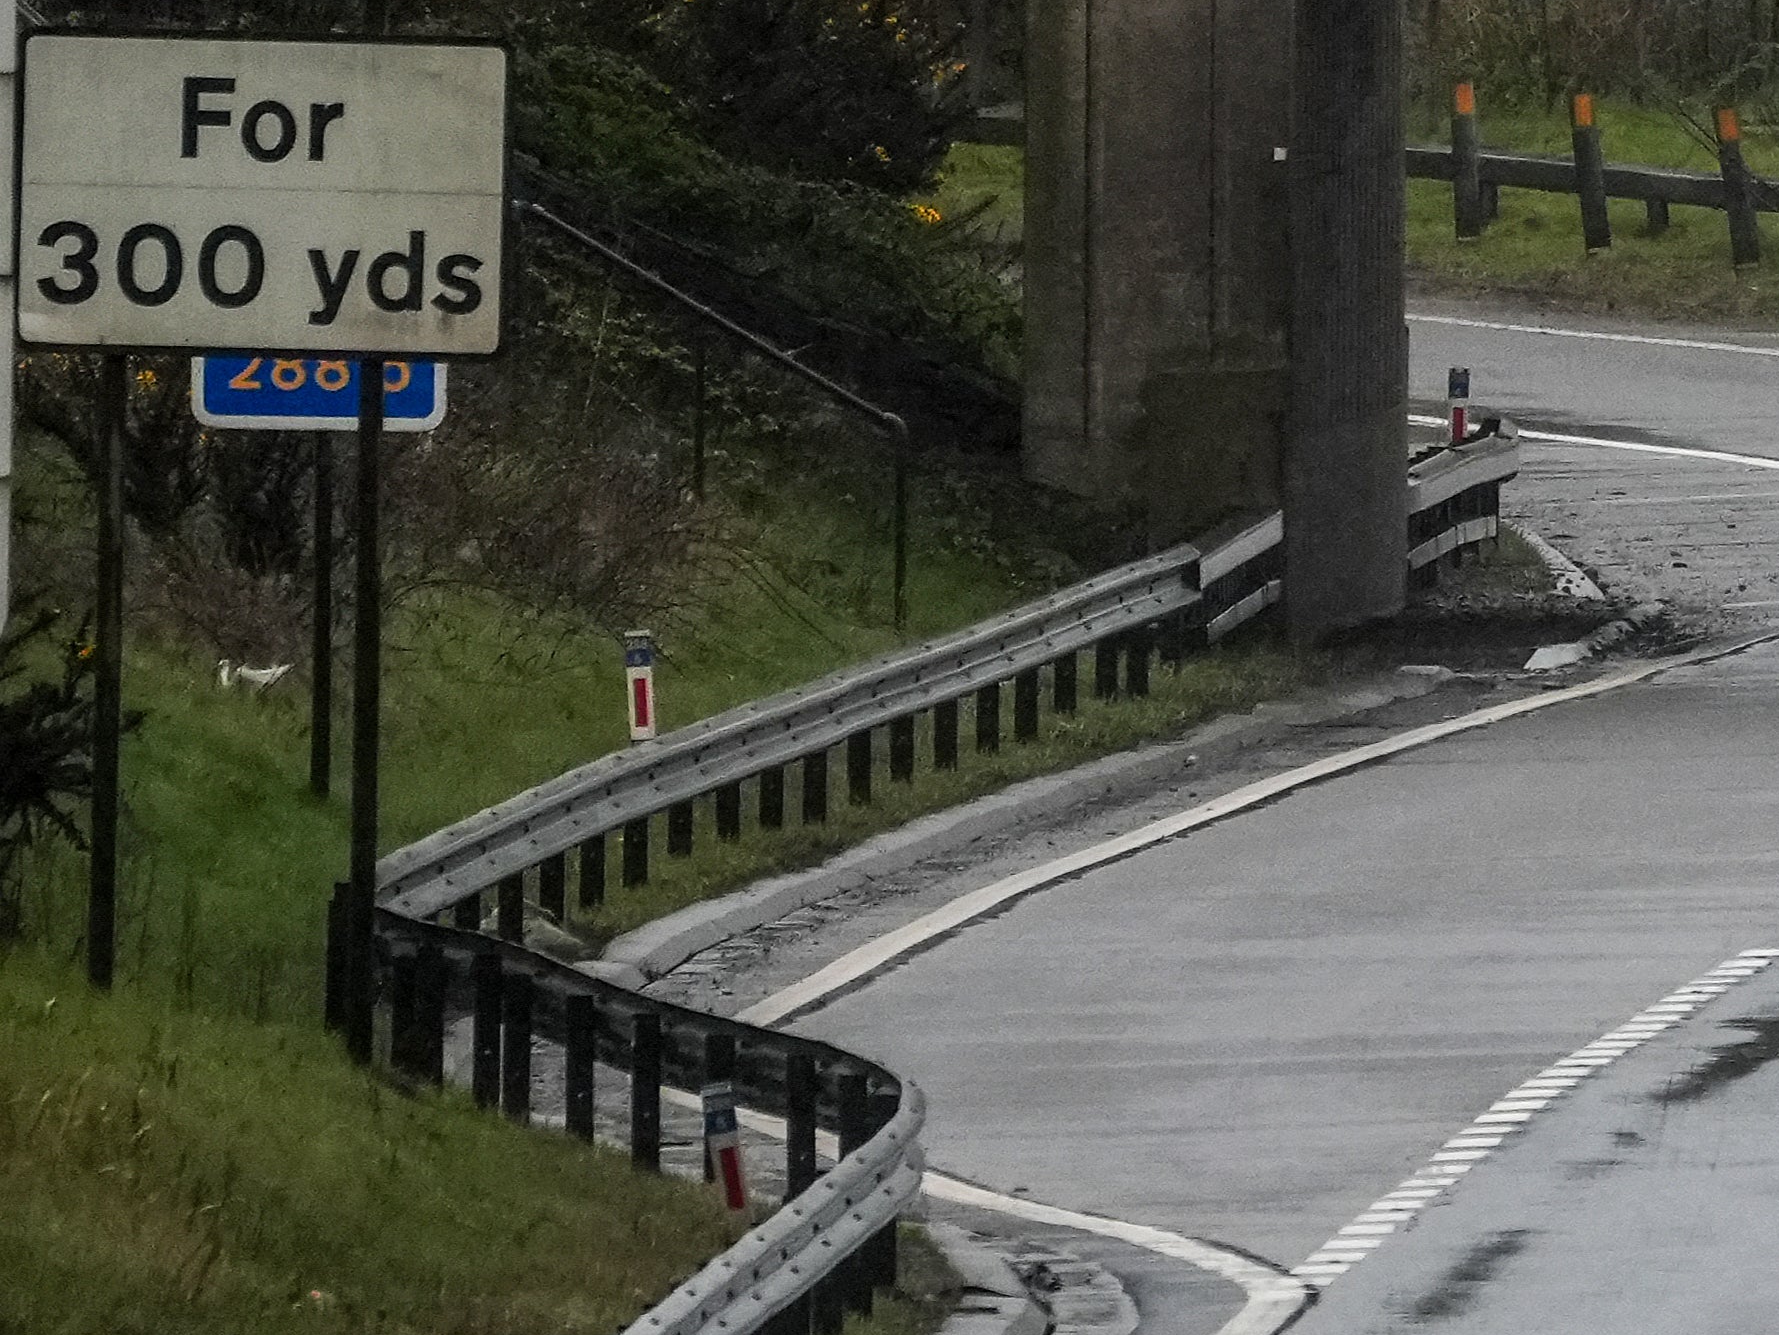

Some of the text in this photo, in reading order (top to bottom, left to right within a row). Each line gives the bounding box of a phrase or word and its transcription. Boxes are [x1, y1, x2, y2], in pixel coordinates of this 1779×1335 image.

[180, 76, 344, 163] For
[36, 221, 485, 326] 300 yds
